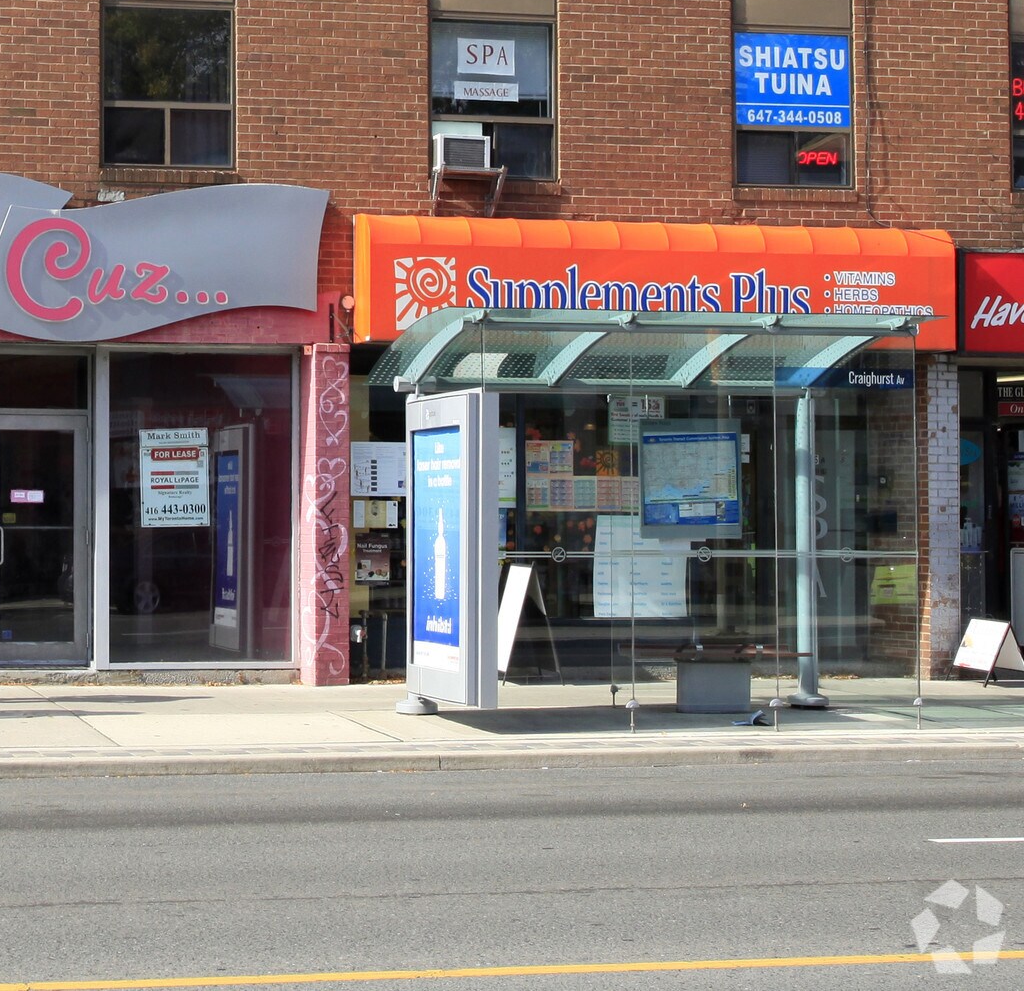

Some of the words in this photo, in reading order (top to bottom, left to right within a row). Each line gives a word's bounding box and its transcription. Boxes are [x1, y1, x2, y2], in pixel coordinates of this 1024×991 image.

[466, 44, 508, 65] SPA
[739, 45, 845, 70] SHIATSU
[754, 73, 832, 96] TUINA
[1012, 78, 1024, 97] B
[464, 88, 508, 97] MASSAGE
[748, 109, 842, 124] 647-344-0508
[5, 217, 229, 322] Cuz...
[834, 271, 896, 286] VITAMINS
[466, 263, 721, 313] Supplements
[730, 268, 811, 314] Plus
[834, 288, 878, 302] HERBS
[970, 295, 1024, 329] Hav
[848, 371, 894, 387] Craighurst
[896, 375, 904, 385] Av
[998, 387, 1013, 397] THE
[174, 431, 200, 439] Smith
[154, 451, 170, 459] FOR
[172, 450, 196, 458] LEASE
[145, 507, 158, 515] 416
[162, 504, 206, 514] 443-0300
